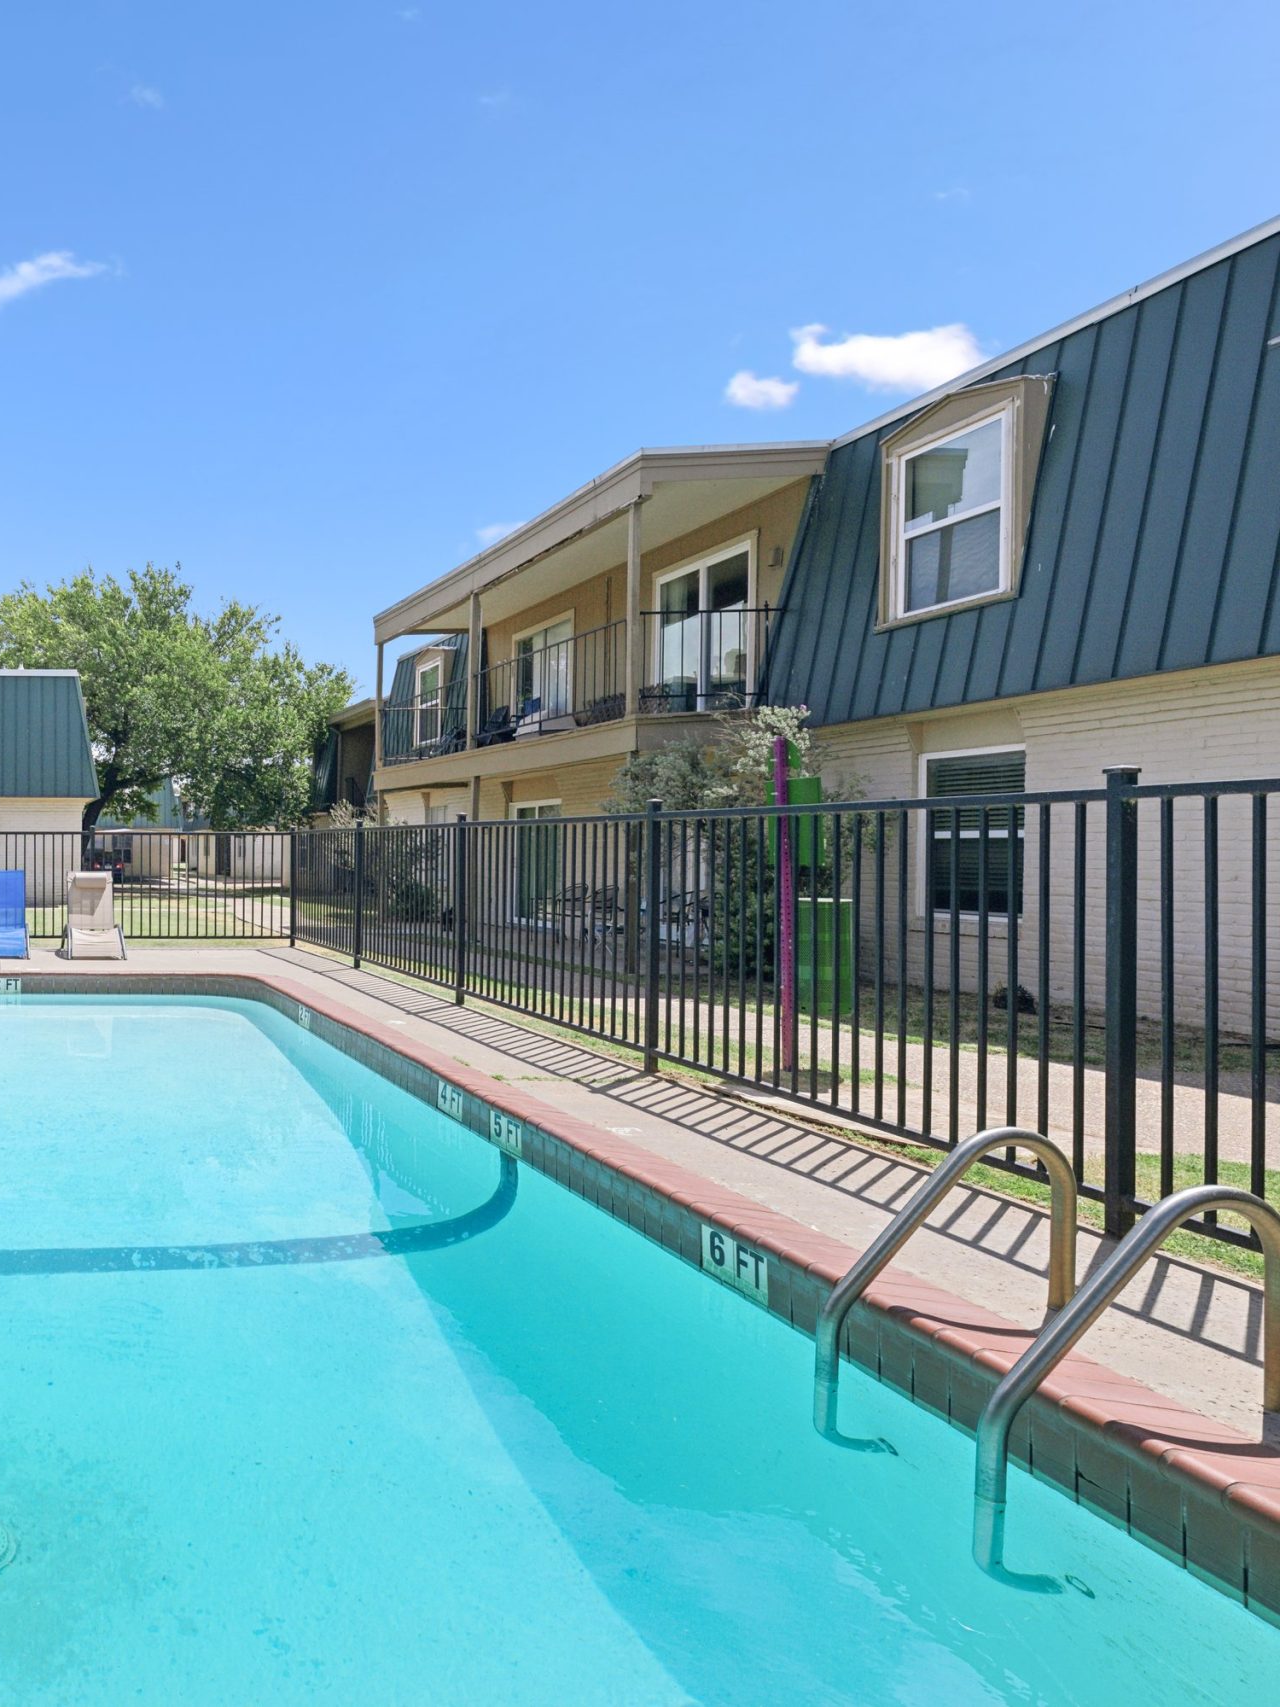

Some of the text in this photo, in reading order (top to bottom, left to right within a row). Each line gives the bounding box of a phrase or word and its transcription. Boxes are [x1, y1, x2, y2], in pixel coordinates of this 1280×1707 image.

[6, 979, 20, 990] FT
[440, 1083, 461, 1113] 4 FT
[494, 1112, 520, 1148] 5 FT
[709, 1230, 764, 1290] 6 FT
